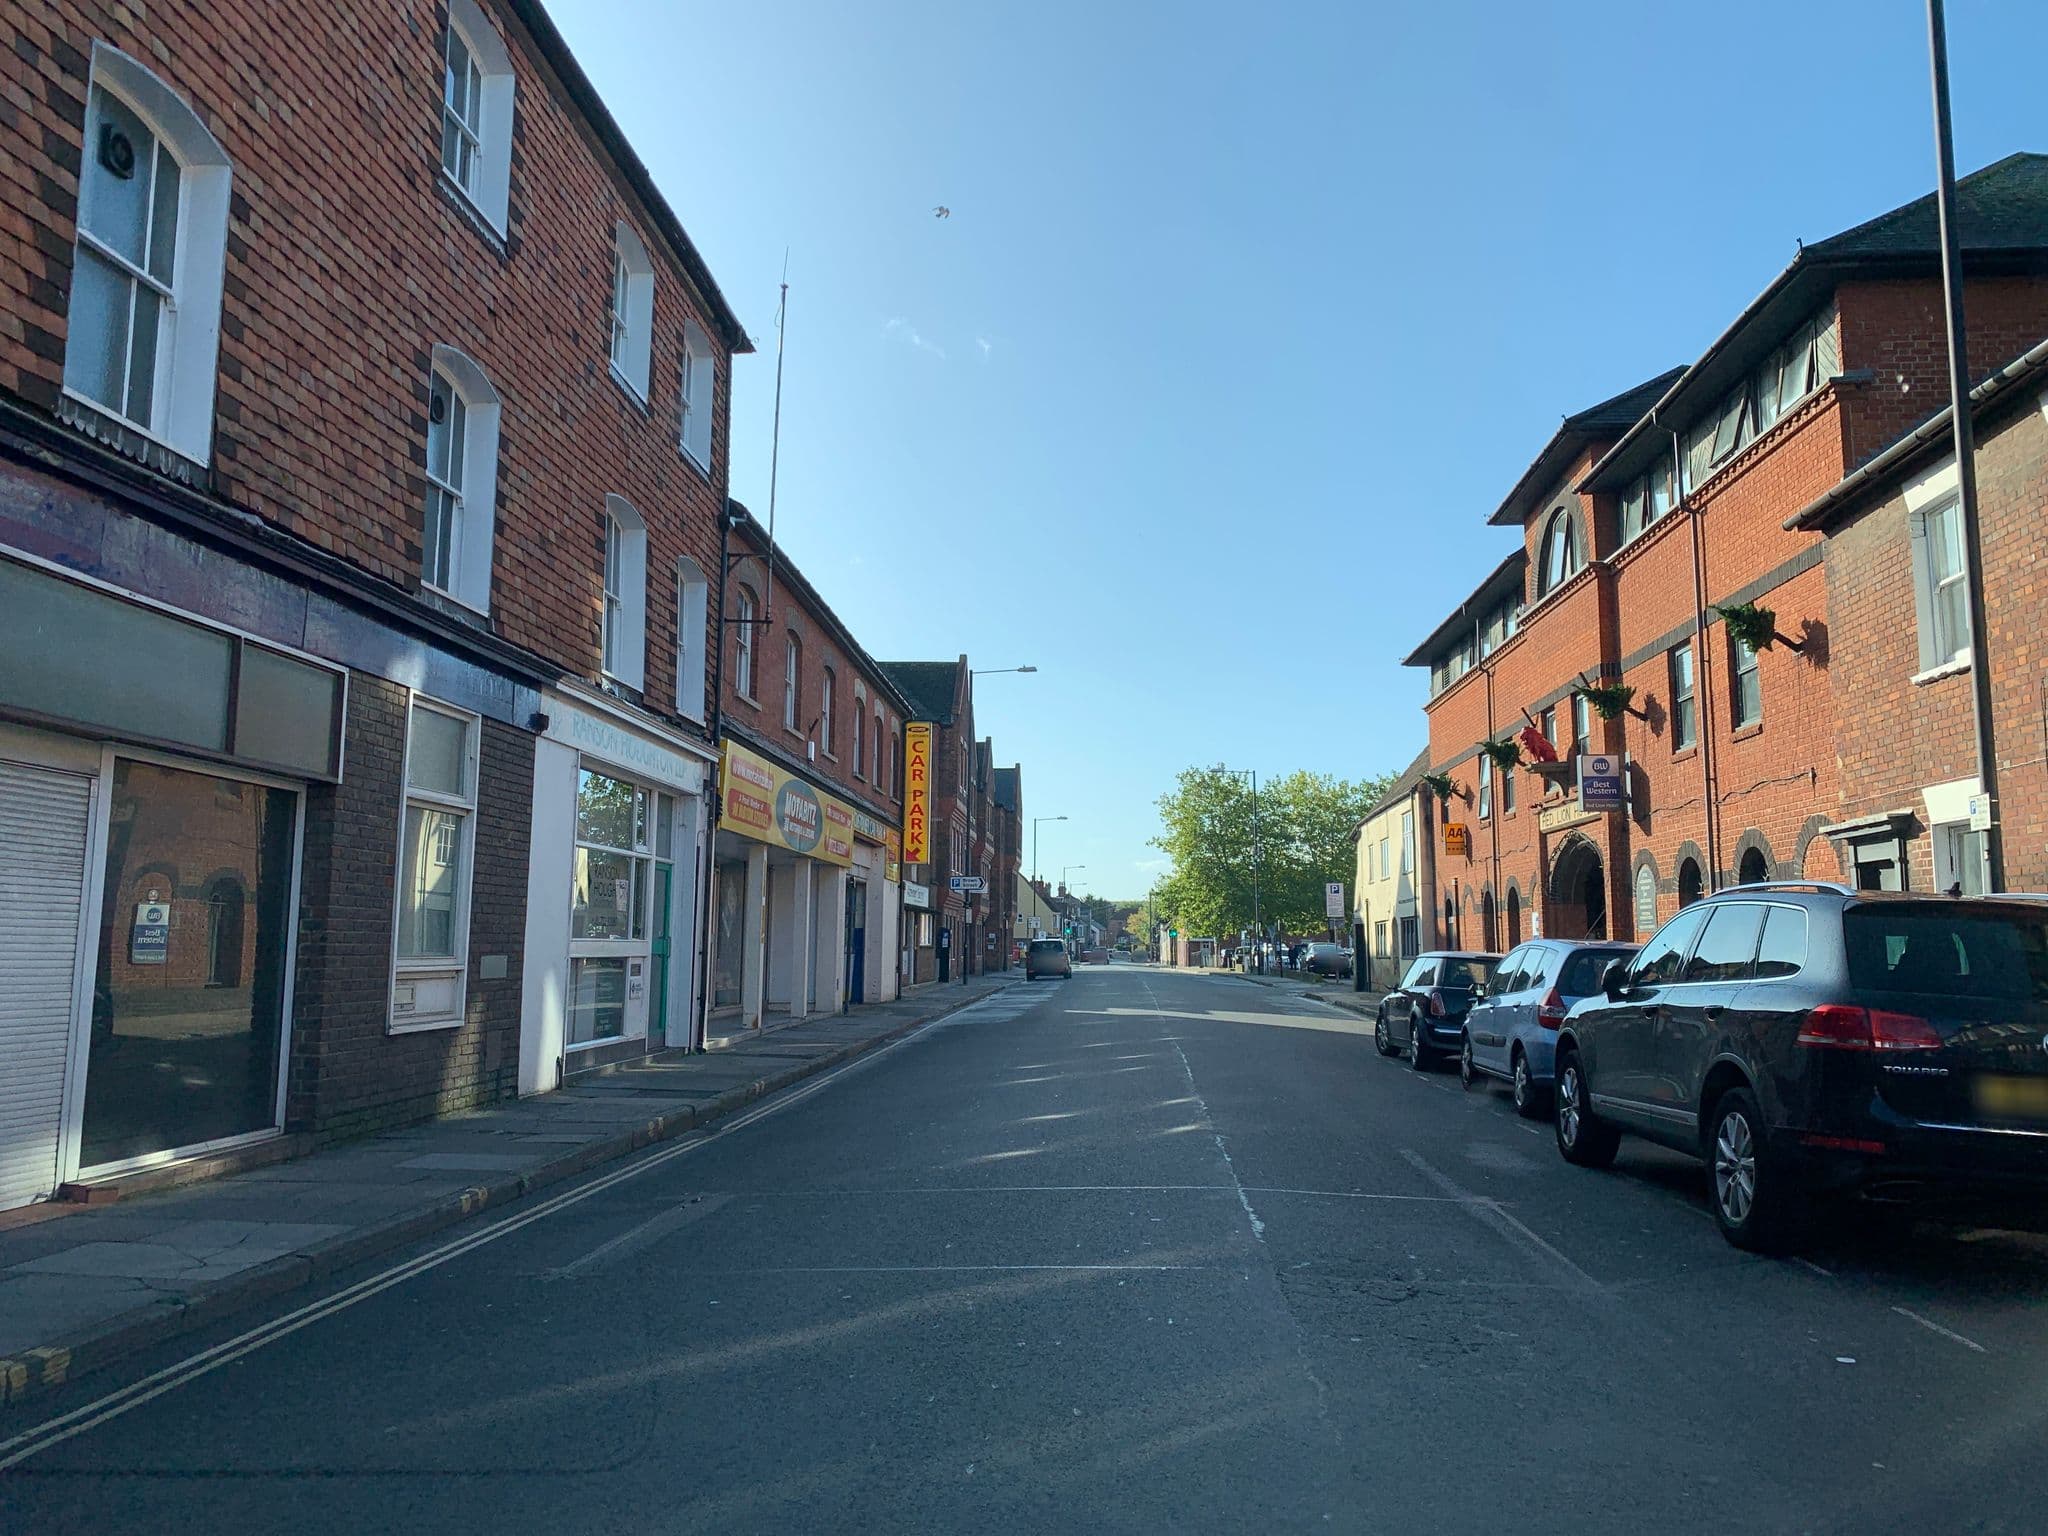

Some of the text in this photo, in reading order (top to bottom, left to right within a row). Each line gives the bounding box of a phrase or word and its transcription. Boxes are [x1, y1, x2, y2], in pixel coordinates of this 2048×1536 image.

[910, 740, 925, 782] CAR
[1593, 762, 1608, 770] BW
[1586, 787, 1617, 795] Western
[909, 789, 924, 845] PARK
[1447, 828, 1463, 838] AA
